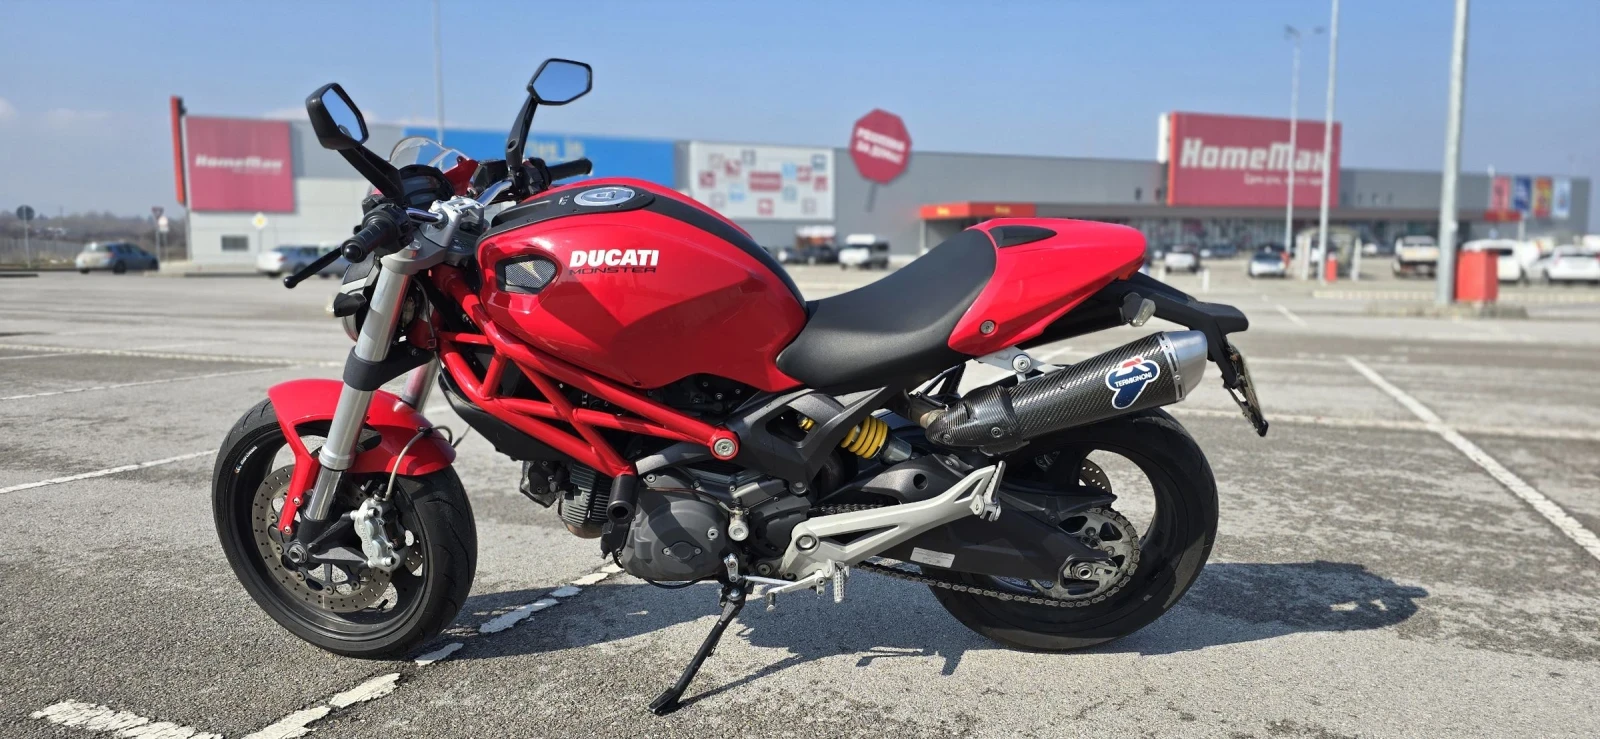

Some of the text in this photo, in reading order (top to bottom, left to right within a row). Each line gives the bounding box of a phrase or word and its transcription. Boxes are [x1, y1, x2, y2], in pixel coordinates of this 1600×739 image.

[569, 248, 660, 268] DUCATI
[568, 266, 657, 276] MONSTER
[1114, 371, 1153, 388] TERMIGNONI
